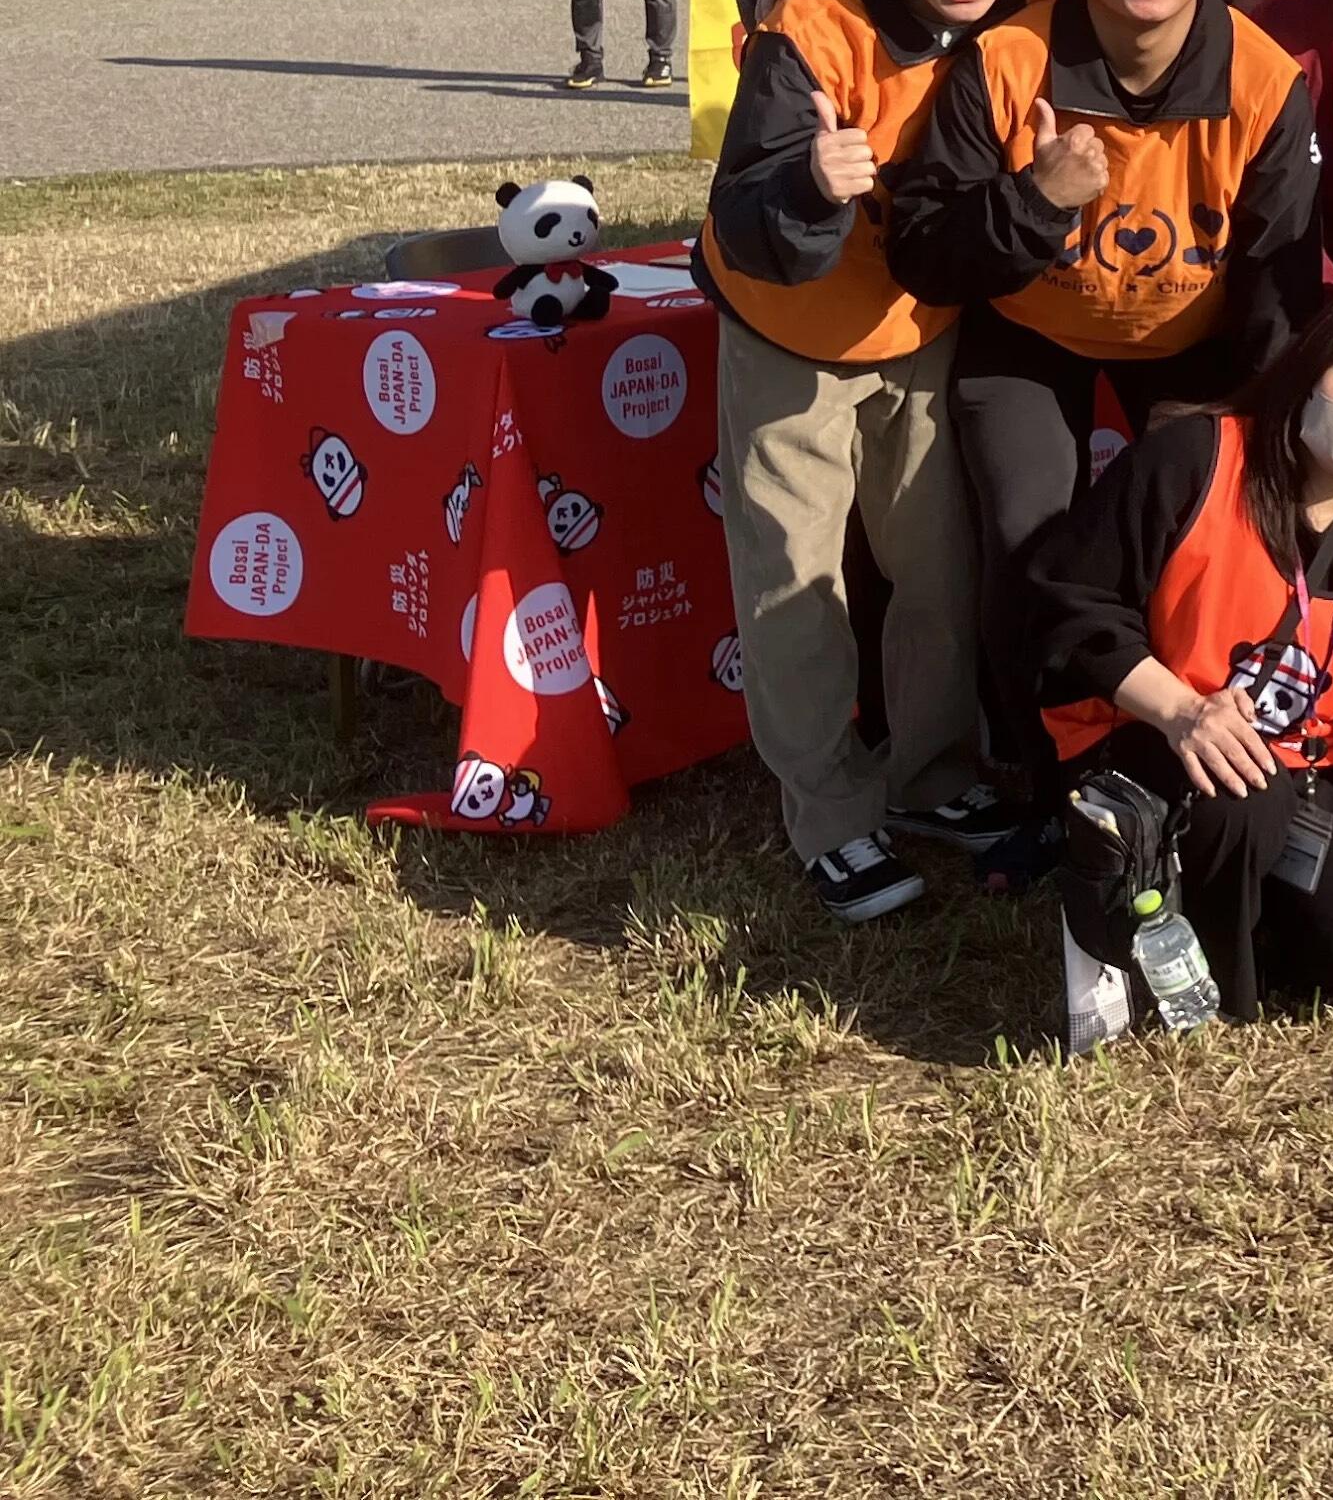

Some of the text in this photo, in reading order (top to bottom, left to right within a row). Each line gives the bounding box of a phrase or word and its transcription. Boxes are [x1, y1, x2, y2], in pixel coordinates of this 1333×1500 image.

[377, 356, 390, 402] Bosai
[625, 352, 662, 374] Bosai
[392, 341, 406, 425] JAPAN-DA
[408, 354, 422, 413] Project
[610, 371, 680, 399] JAPAN-DA
[623, 395, 670, 419] Project
[229, 540, 249, 584] Bosai
[250, 523, 271, 606] JAPAN-DA
[272, 538, 290, 594] Project
[636, 560, 676, 591] 防災
[524, 599, 570, 634] Bosai
[617, 599, 693, 630] プロジェクト
[534, 644, 586, 680] Projec
